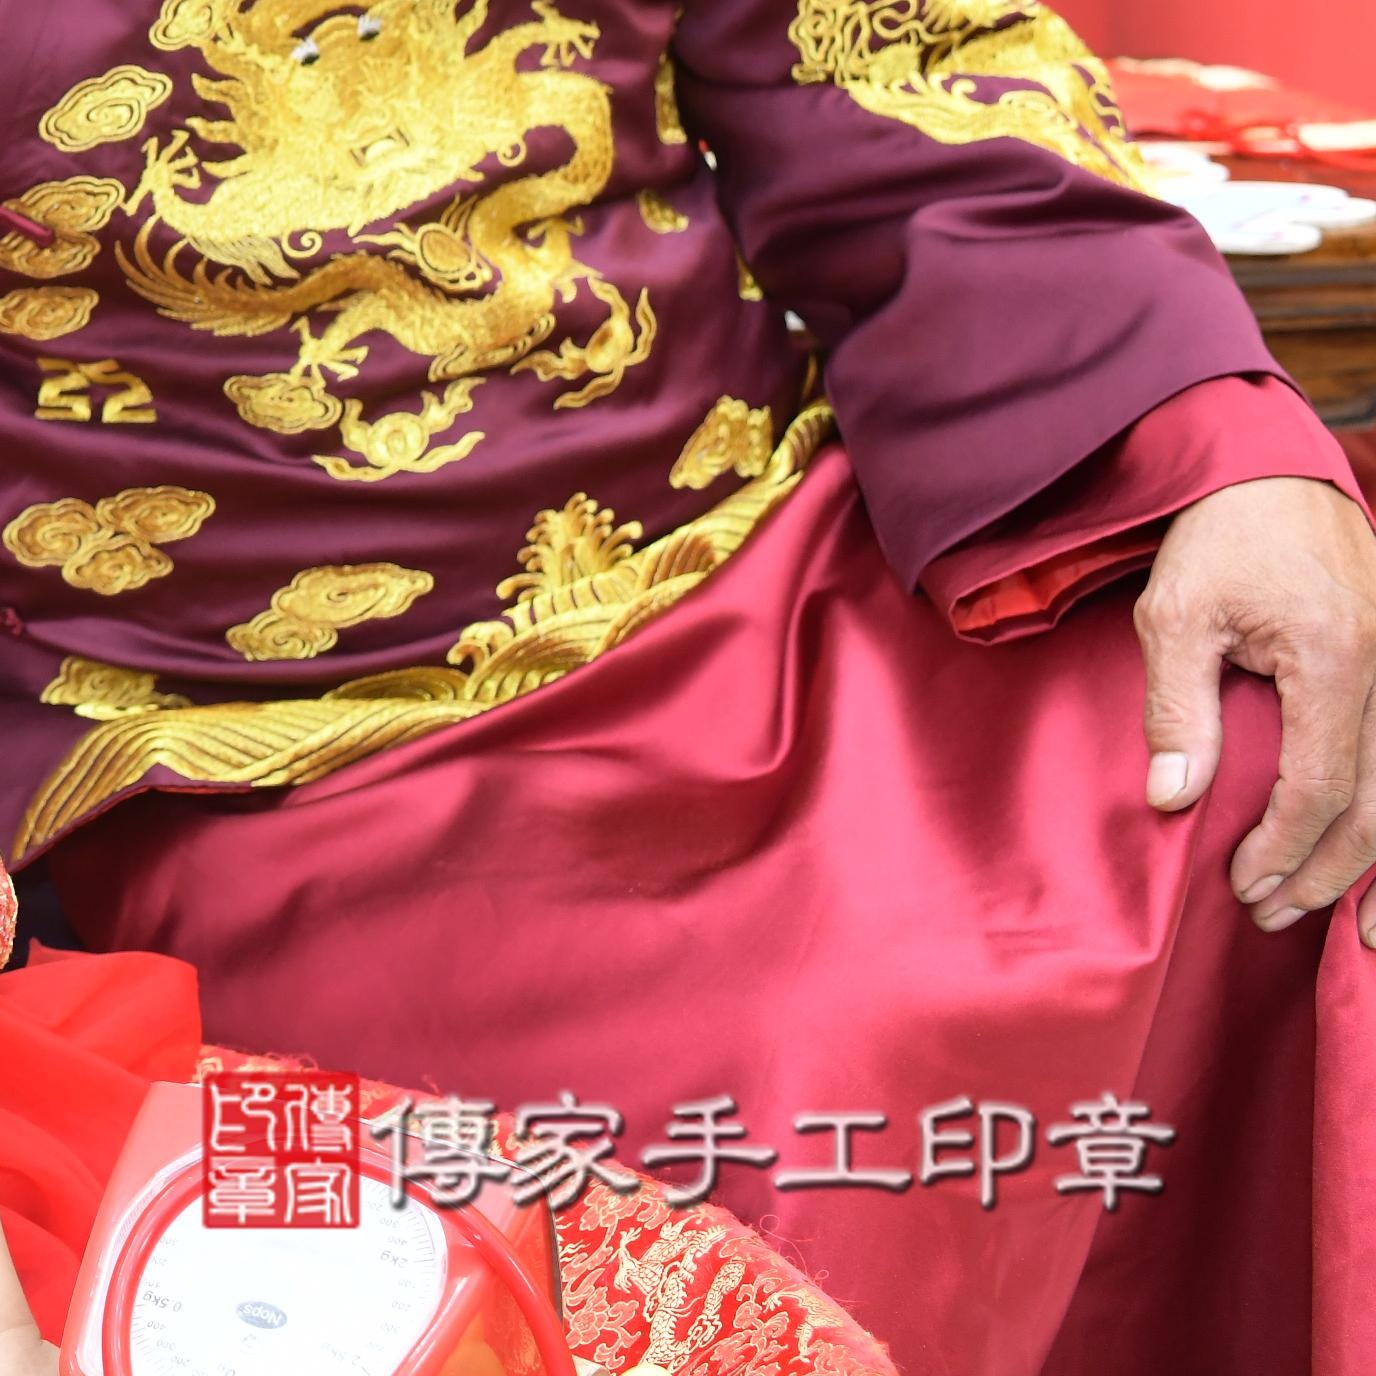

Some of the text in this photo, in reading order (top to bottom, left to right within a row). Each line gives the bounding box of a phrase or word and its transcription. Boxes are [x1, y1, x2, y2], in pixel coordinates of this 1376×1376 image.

[380, 1250, 408, 1269] 2kg
[142, 1291, 182, 1312] 0.5kg
[243, 1304, 282, 1327] Nops
